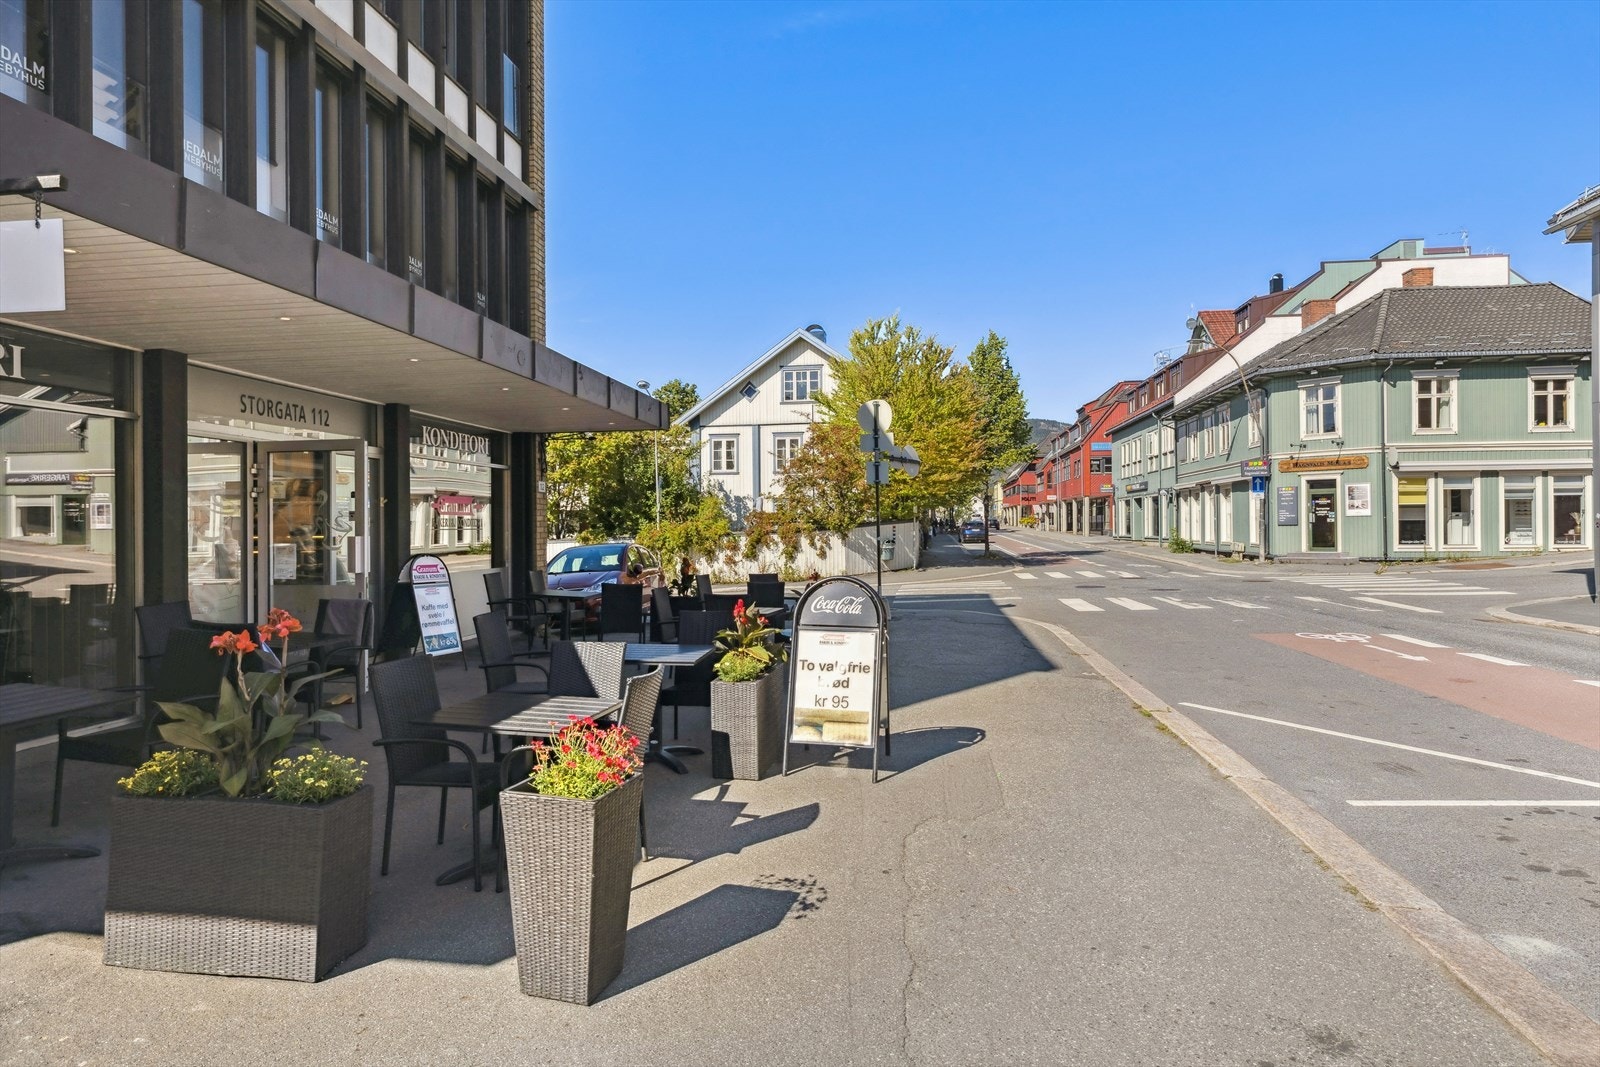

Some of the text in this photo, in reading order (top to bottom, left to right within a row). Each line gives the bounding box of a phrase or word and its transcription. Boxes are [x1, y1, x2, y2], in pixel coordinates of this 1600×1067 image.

[240, 394, 330, 427] STORGATA 112
[422, 425, 491, 457] KONDITORI
[800, 659, 815, 671] To
[814, 694, 849, 709] kr 95
